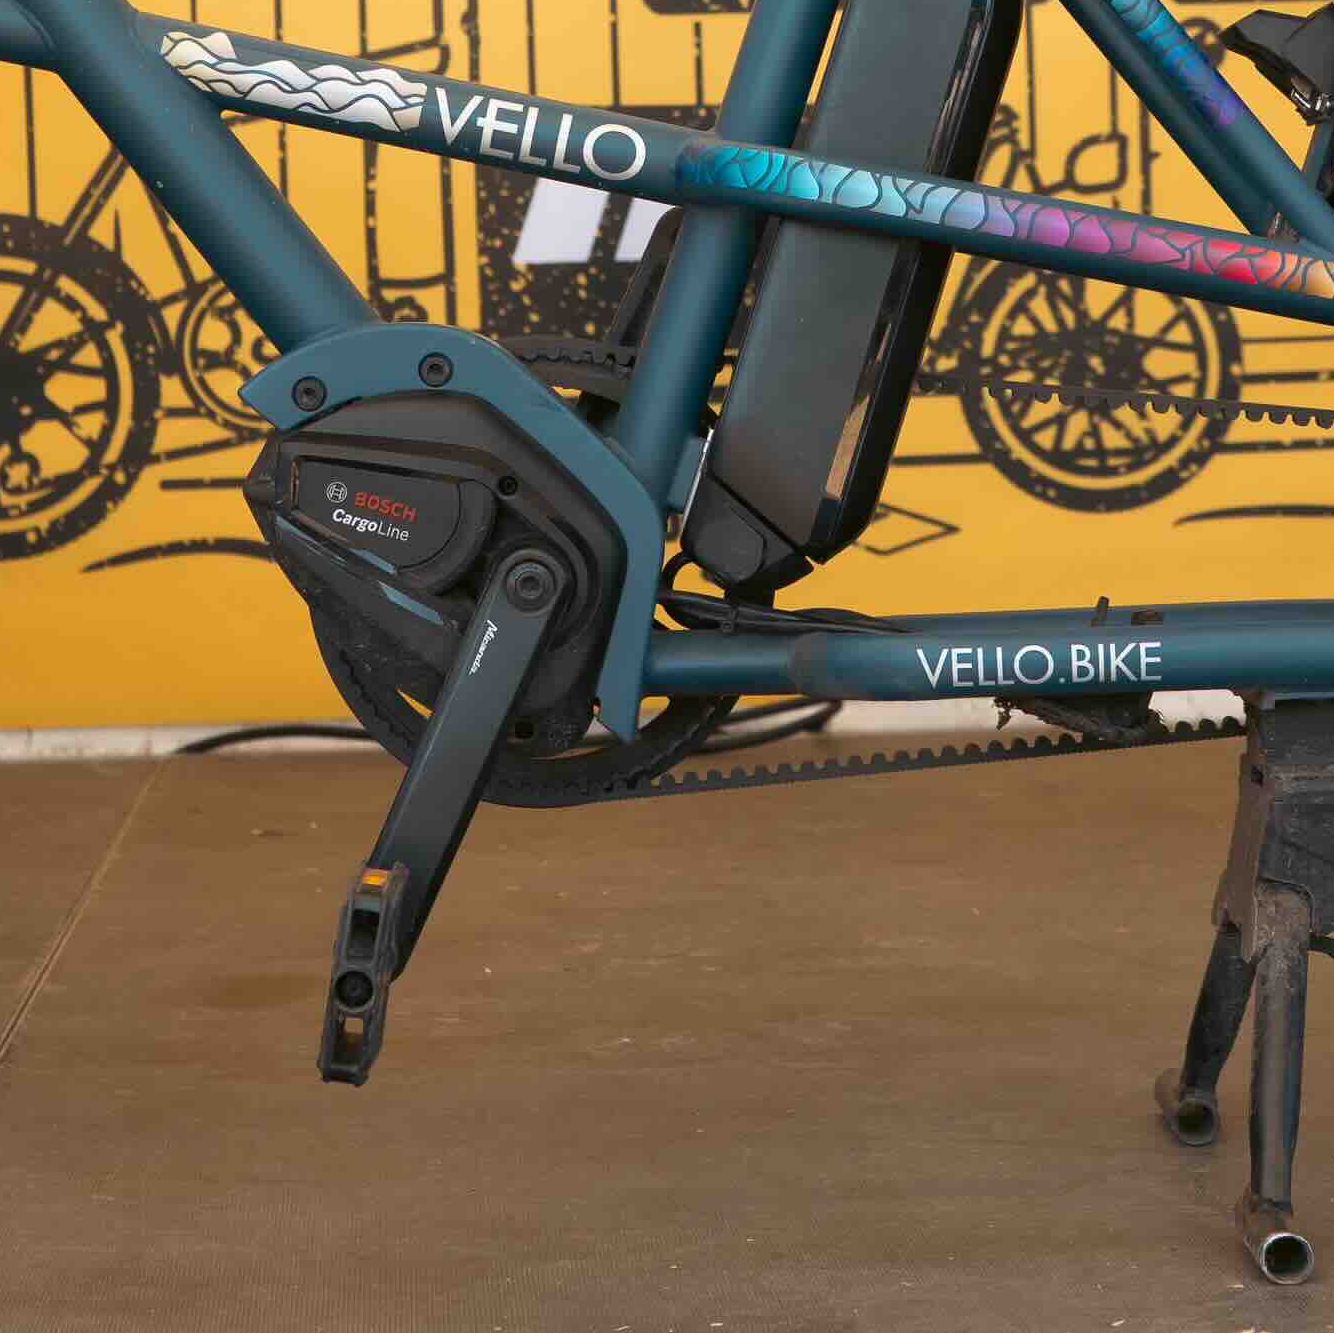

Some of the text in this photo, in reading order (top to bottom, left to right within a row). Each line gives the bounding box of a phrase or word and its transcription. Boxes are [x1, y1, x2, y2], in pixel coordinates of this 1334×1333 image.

[434, 86, 647, 181] VELLO
[354, 491, 417, 524] BOSCH
[916, 641, 1164, 689] VELLO.BIKE
